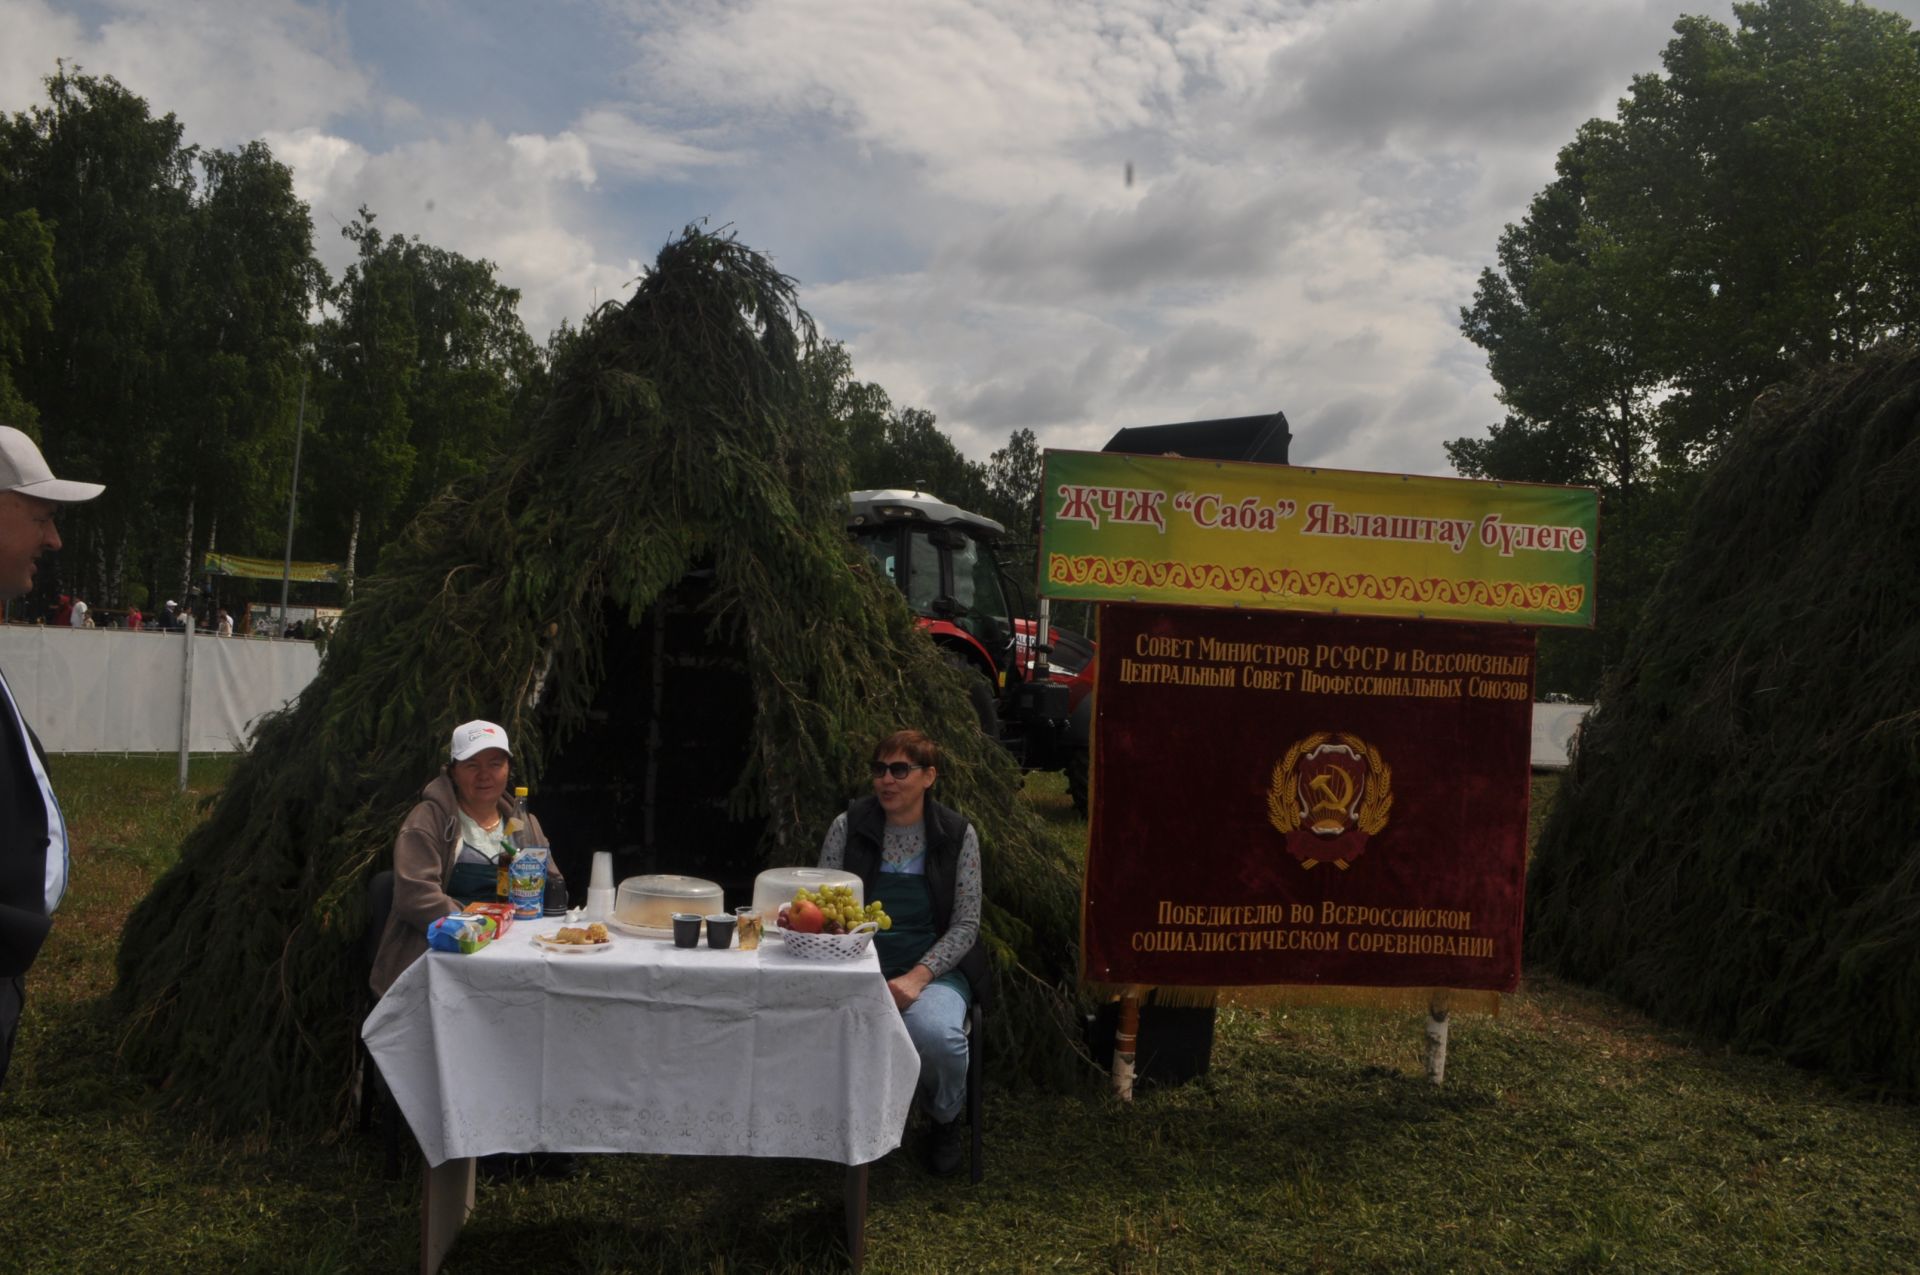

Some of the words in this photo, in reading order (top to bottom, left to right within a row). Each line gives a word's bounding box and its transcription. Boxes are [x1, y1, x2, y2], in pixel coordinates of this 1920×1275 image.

[1303, 503, 1474, 553] Явлаштау
[1481, 514, 1586, 557] бүлеге
[1135, 633, 1194, 660] СОВЕТ
[1199, 637, 1310, 667] МИНИСТРОВ
[1315, 644, 1389, 671] РСФСР
[1411, 649, 1530, 676] ВСЕСОЮЗНЫЙ
[1120, 658, 1236, 688] ЦЕНТРАЛЬНЫЙ
[1242, 665, 1295, 691] СОВЕТ
[1301, 669, 1463, 698] ПРОФЕССИОНАЛЬНЫХ
[1468, 675, 1528, 700] СОЮЗОВ
[1157, 900, 1283, 927] ПОБЕДИТЕЛЮ
[1290, 903, 1314, 924] ВО
[1320, 900, 1472, 930] ВСЕРОССИЙСКОМ
[1131, 930, 1340, 952] СОЦИАЛИСТИЧЕСКОМ
[1347, 931, 1495, 958] СОРЕВНОВАНИИ
